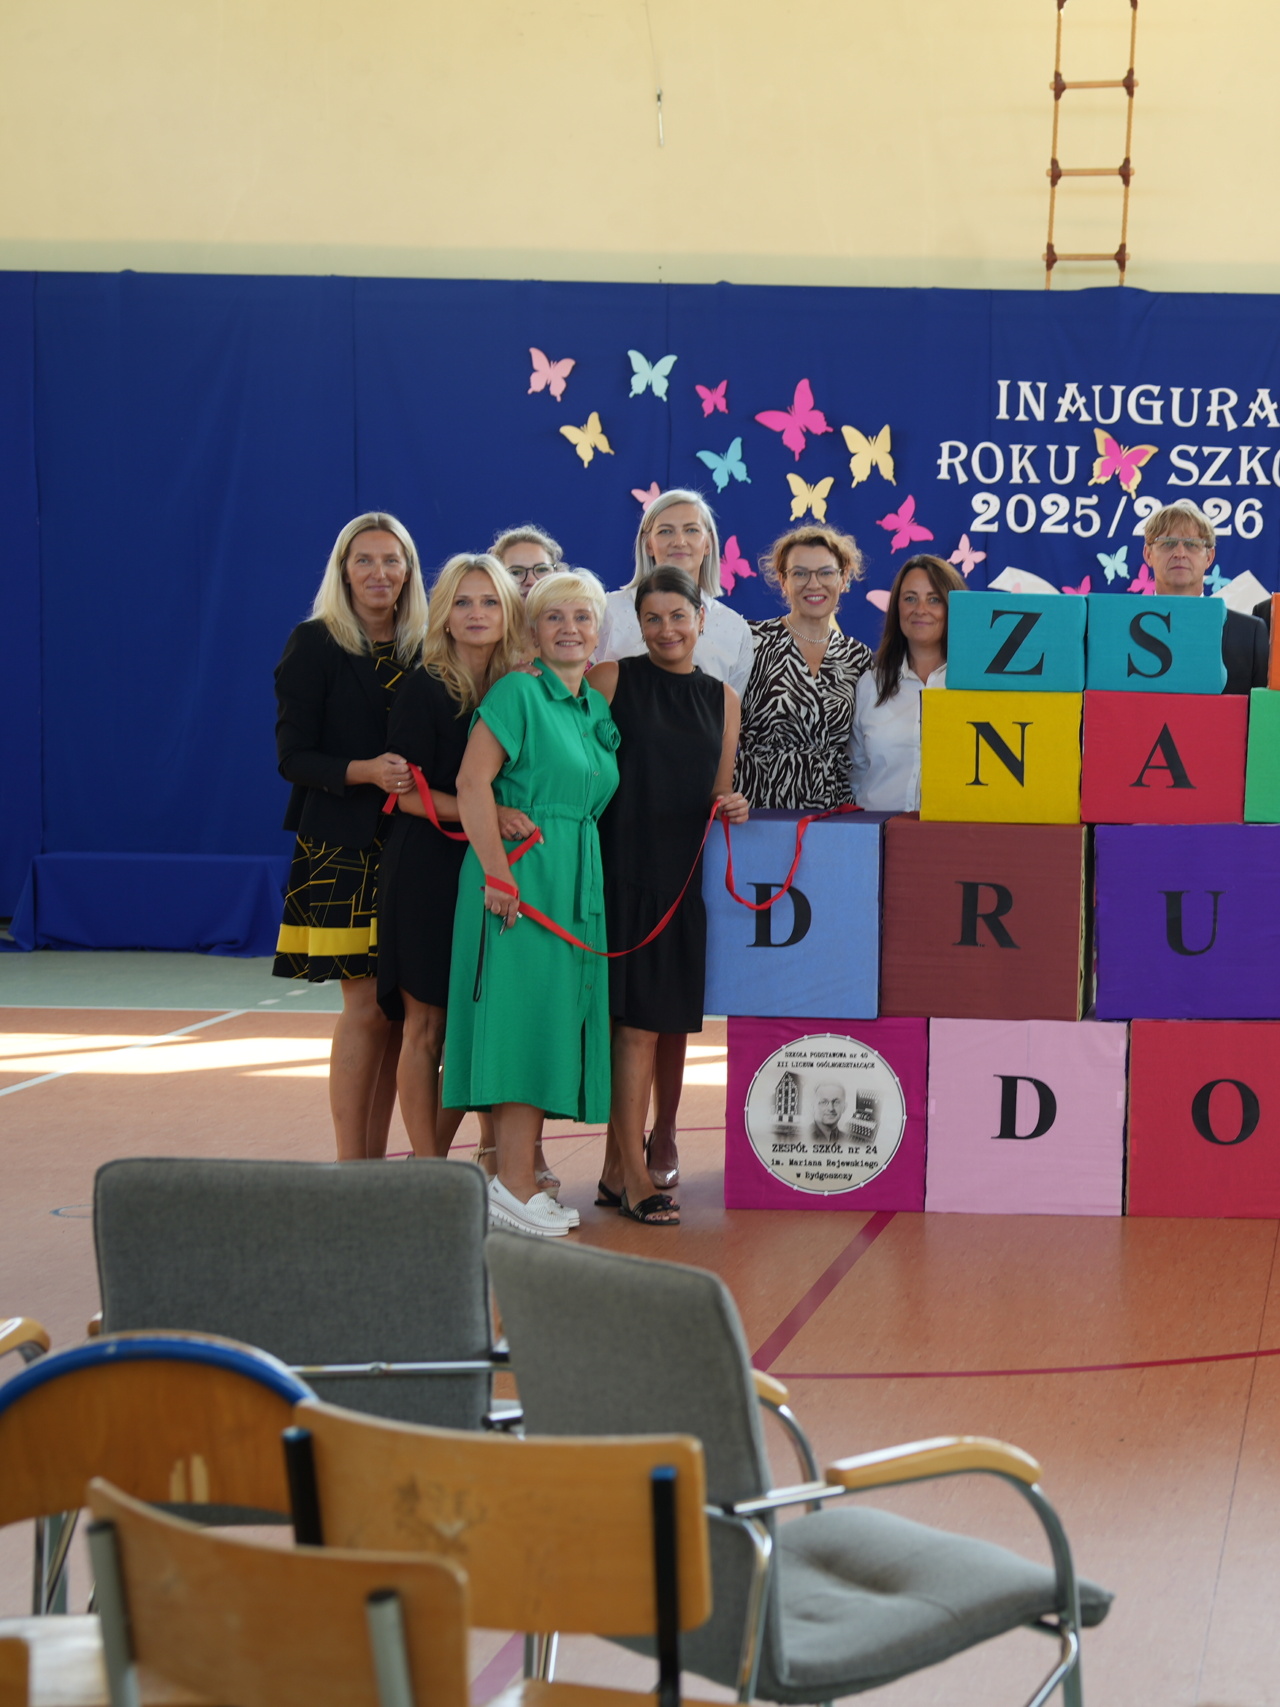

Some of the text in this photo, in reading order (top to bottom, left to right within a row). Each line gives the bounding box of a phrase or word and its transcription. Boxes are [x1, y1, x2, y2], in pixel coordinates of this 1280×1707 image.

[937, 440, 1081, 485] ROKU
[969, 492, 1265, 540] 2025/226
[771, 1142, 878, 1154] ZESPÓŁ SZKÓŁ nr 24
[771, 1158, 784, 1166] im.
[826, 1159, 879, 1169] Rejewskiego
[805, 1171, 853, 1181] Bydgoszczy
